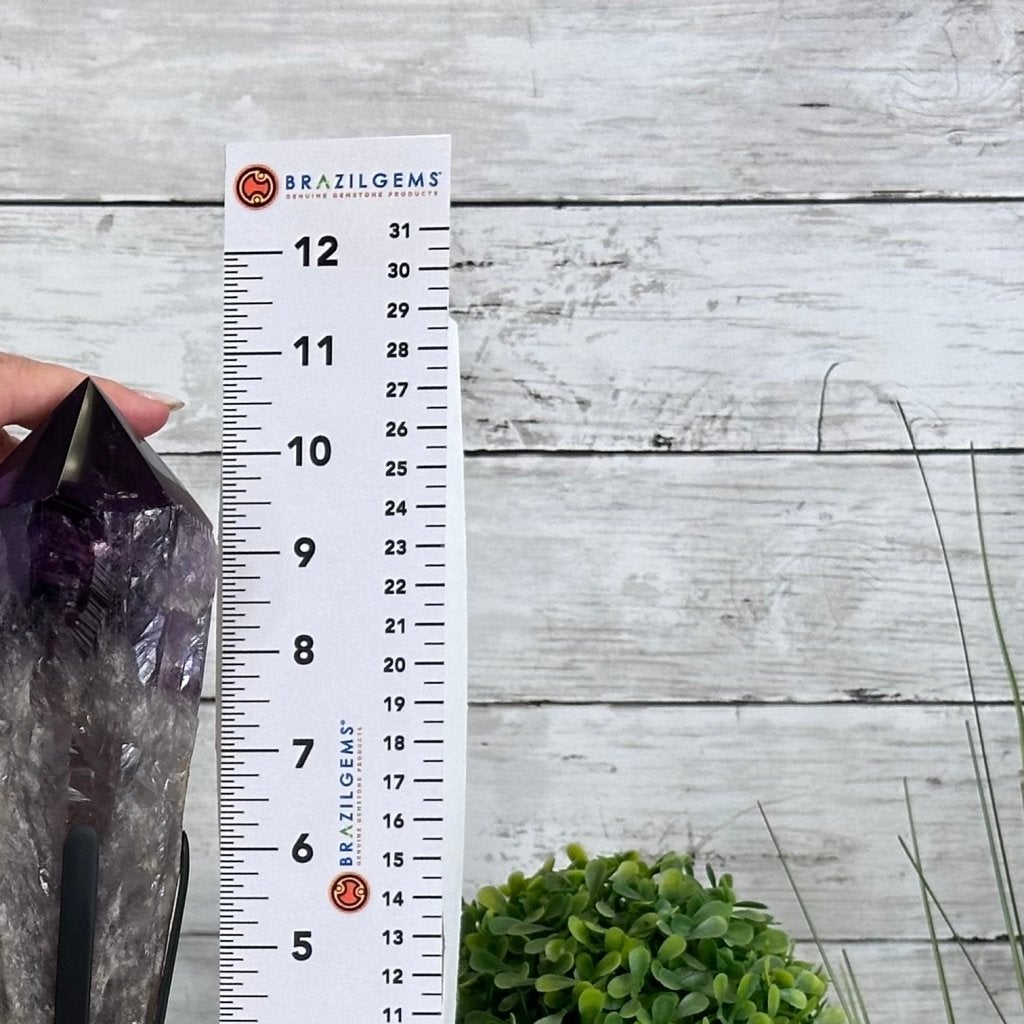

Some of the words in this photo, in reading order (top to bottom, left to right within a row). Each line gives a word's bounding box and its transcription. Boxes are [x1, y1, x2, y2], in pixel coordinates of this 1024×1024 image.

[389, 222, 410, 239] 31
[294, 235, 339, 267] 12
[387, 262, 410, 279] 30
[386, 302, 410, 319] 29
[293, 335, 333, 367] 11
[386, 341, 409, 359] 28
[385, 381, 409, 398] 27
[385, 421, 408, 438] 26
[287, 434, 332, 467] 10
[385, 460, 408, 477] 25
[384, 499, 408, 517] 24
[293, 536, 316, 568] 9
[384, 539, 407, 556] 23
[384, 578, 407, 595] 22
[384, 617, 406, 634] 21
[293, 634, 315, 666] 8
[383, 656, 406, 673] 20
[383, 696, 406, 712] 19
[383, 734, 405, 751] 18
[292, 738, 315, 769] 7
[383, 774, 405, 790] 17
[382, 813, 405, 829] 16
[291, 832, 314, 864] 6
[382, 851, 404, 868] 15
[382, 890, 404, 907] 14
[291, 930, 313, 962] 5
[382, 929, 404, 946] 13
[382, 968, 404, 985] 12
[382, 1007, 402, 1023] 11
